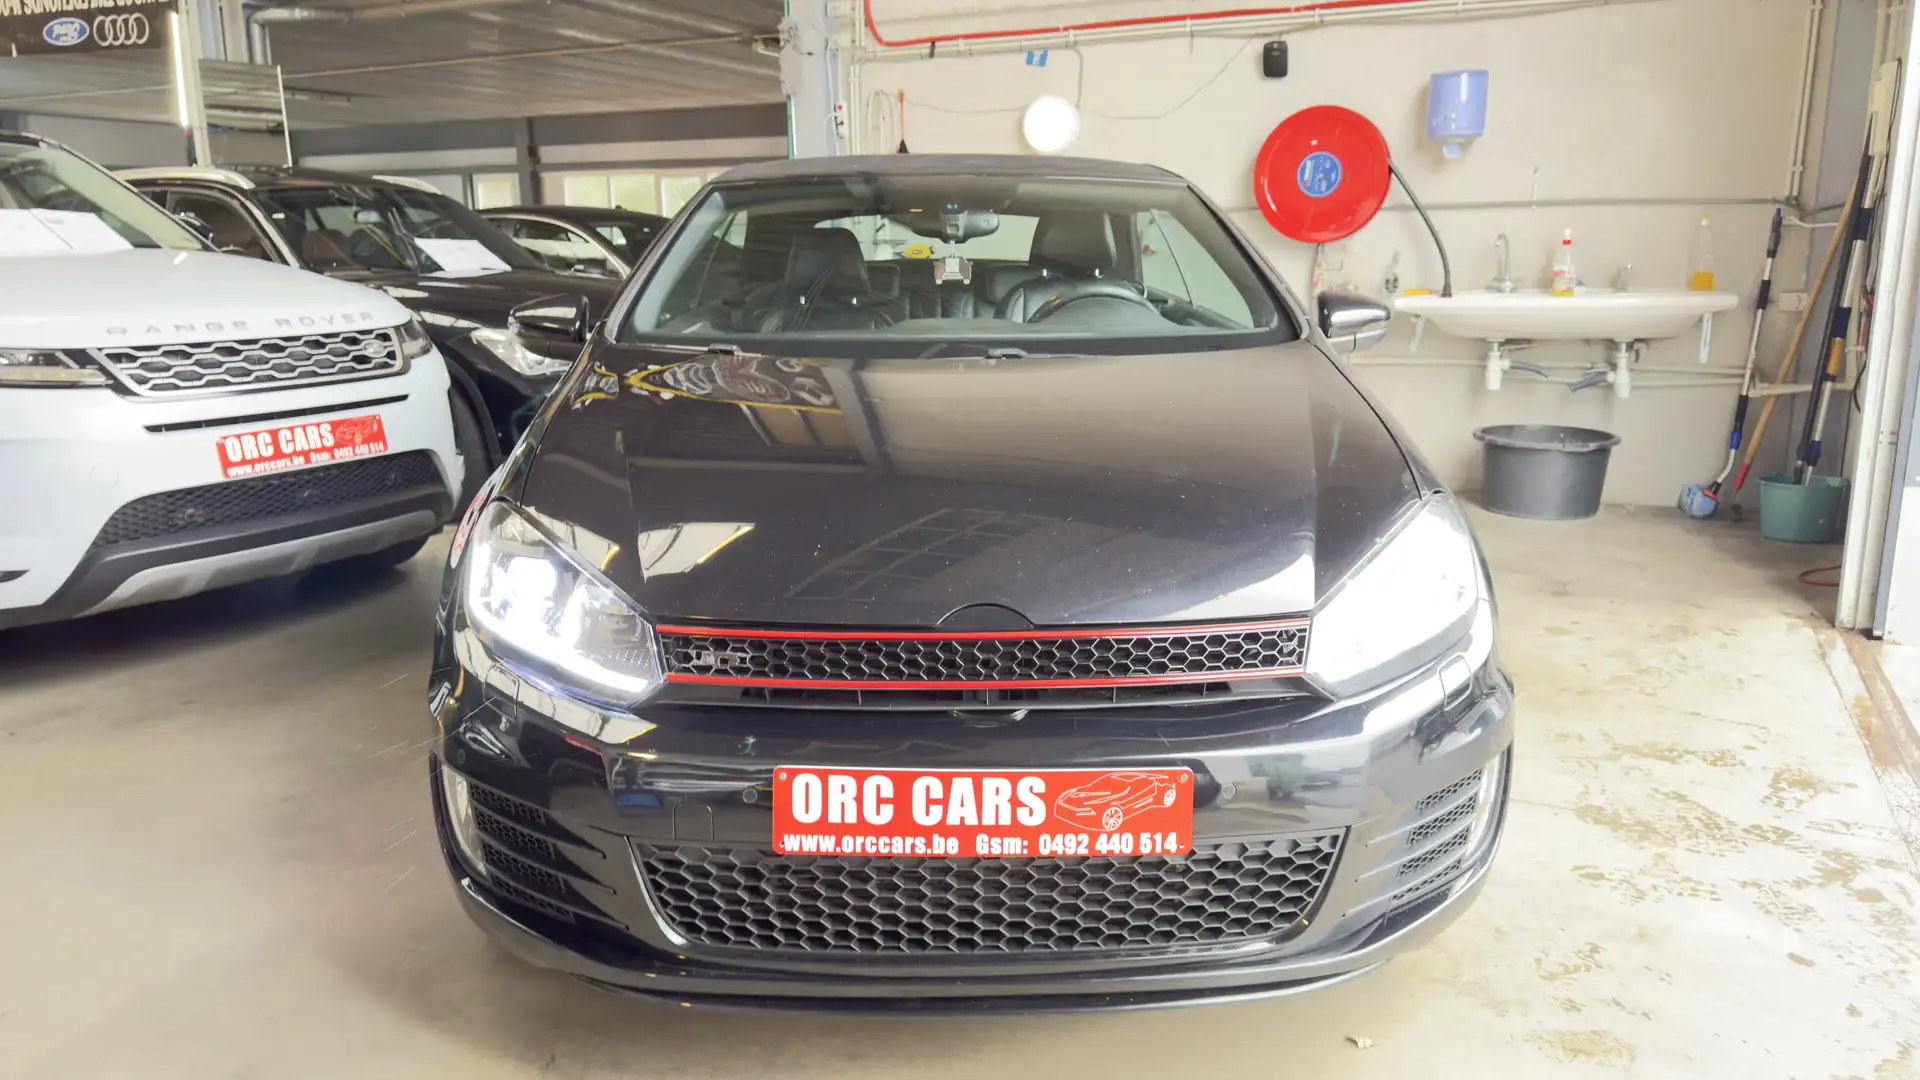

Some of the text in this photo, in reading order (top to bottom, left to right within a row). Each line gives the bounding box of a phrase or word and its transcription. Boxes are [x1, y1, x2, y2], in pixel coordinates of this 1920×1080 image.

[106, 312, 374, 336] RANGE ROVER
[225, 423, 335, 462] ORC CARS
[792, 773, 1046, 826] ORC CARS
[783, 833, 1177, 855] www.orccars.be Gsm: 0492 440 514
